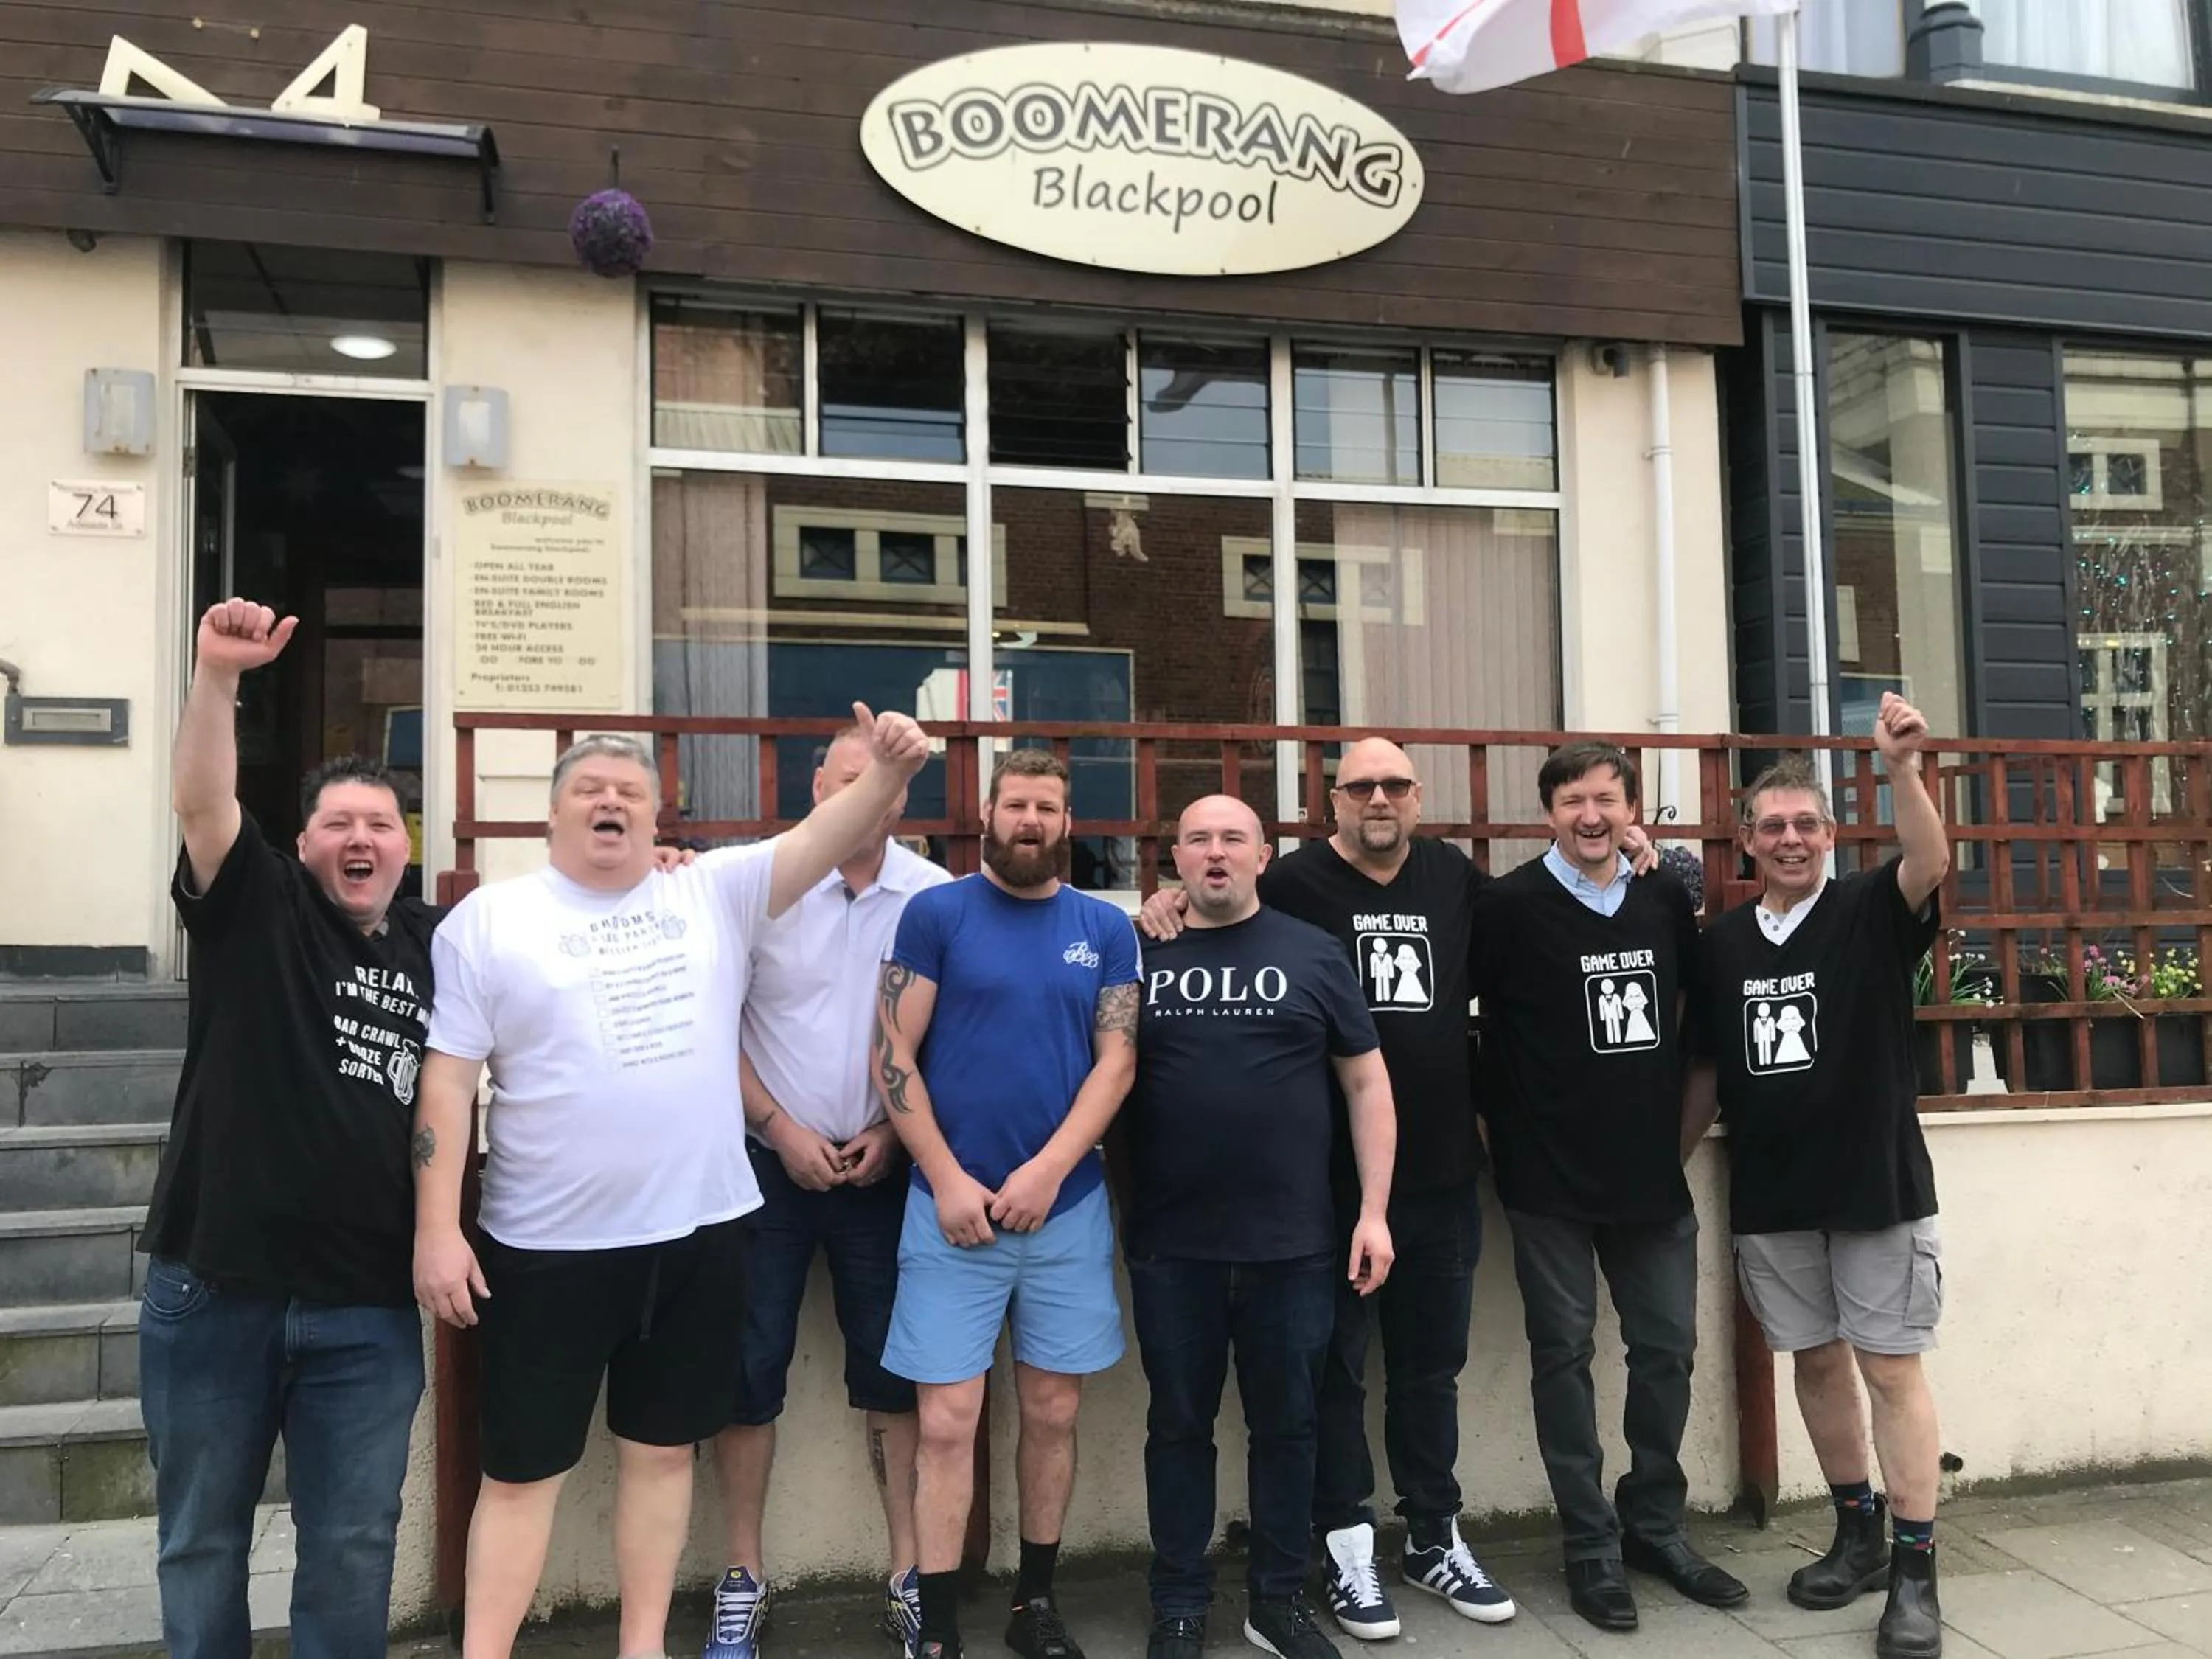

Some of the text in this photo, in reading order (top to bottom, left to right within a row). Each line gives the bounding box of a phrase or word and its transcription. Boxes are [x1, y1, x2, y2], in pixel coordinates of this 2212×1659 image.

[889, 82, 1403, 207] BOOMERANG
[1032, 164, 1279, 234] Blackpool
[72, 493, 119, 519] 74
[463, 489, 611, 520] BOOMERANG
[474, 561, 504, 571] OPEN
[1352, 914, 1428, 932] GAME OVER
[1580, 949, 1655, 973] GAME OVER
[1147, 966, 1288, 1005] POLO
[1743, 971, 1815, 995] GAME OVER
[335, 981, 417, 1017] I'M THE BEST
[1155, 1008, 1275, 1017] RALPH LAUREN
[334, 1015, 401, 1048] BAR CRAWL
